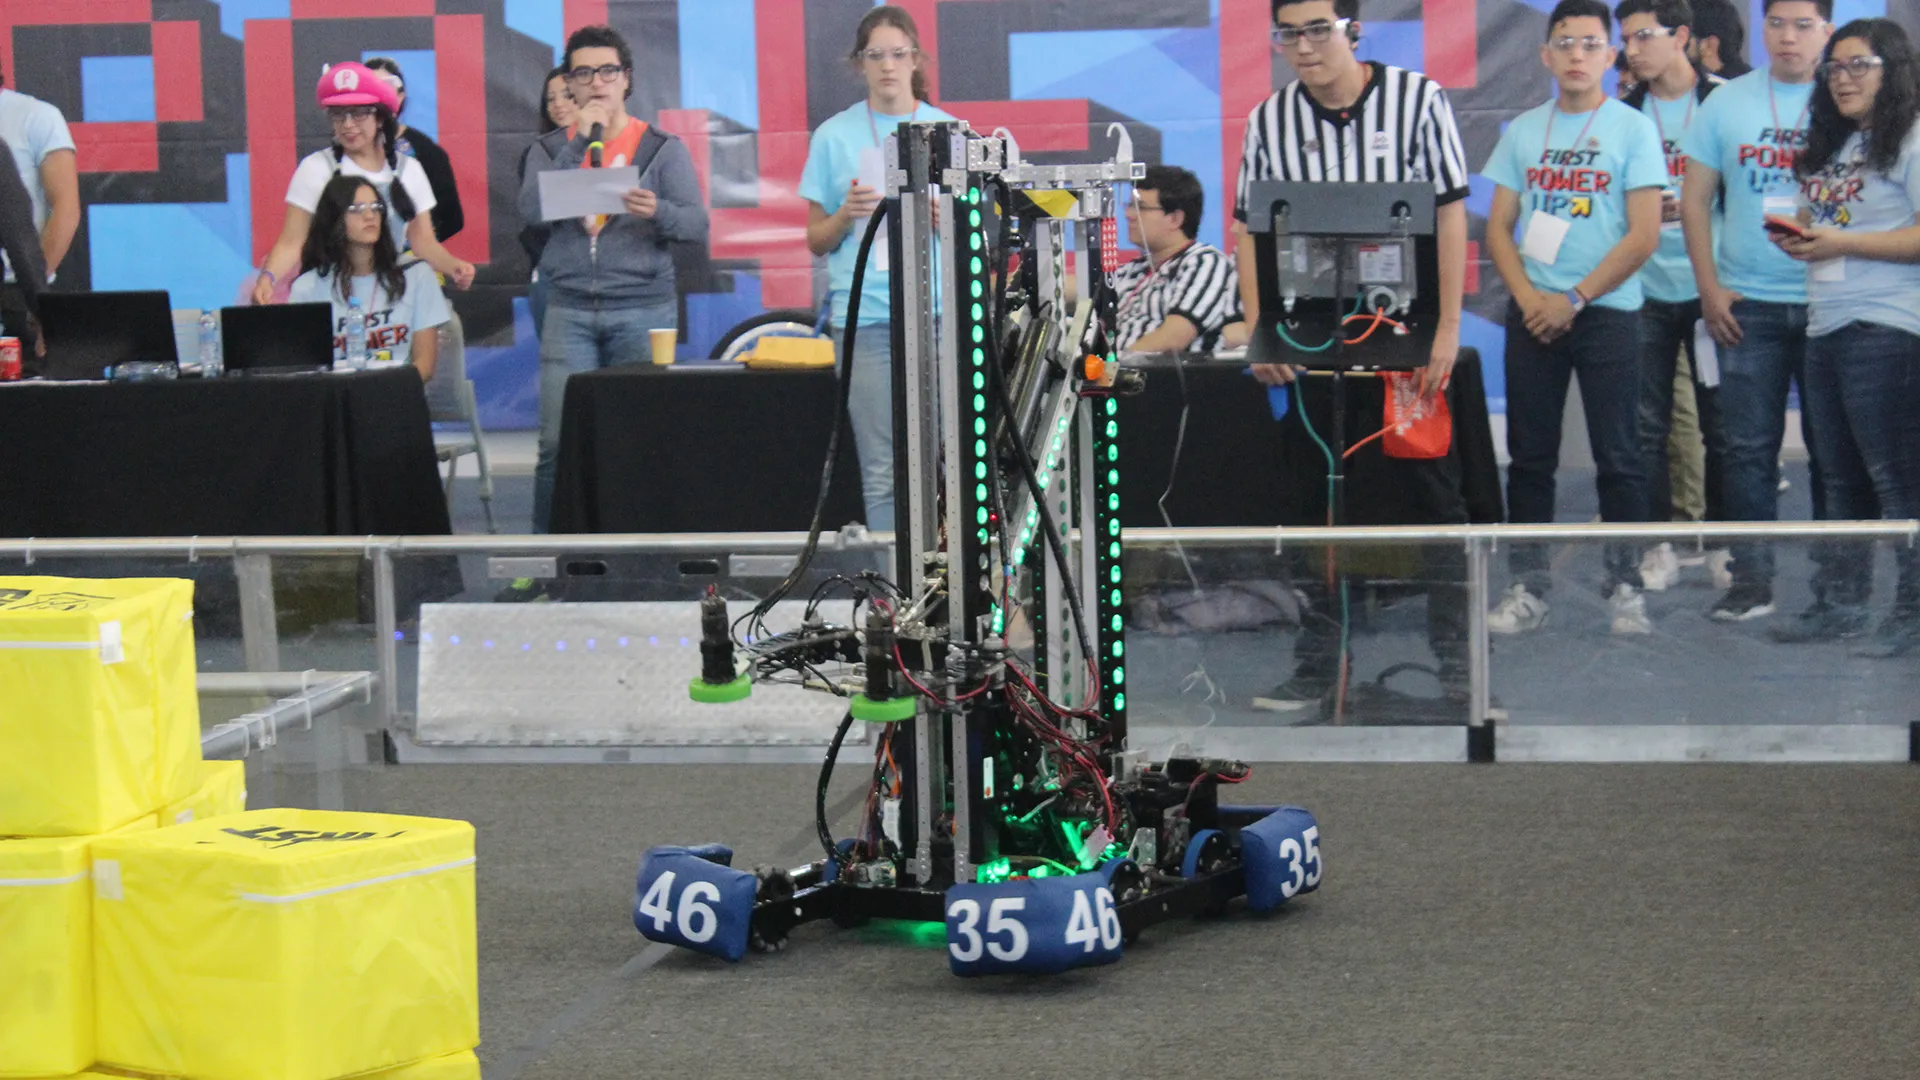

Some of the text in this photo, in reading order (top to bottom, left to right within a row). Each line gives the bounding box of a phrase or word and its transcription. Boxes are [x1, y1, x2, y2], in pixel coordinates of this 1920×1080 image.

[1759, 127, 1808, 145] FIRS
[1539, 149, 1601, 166] FIRST
[1738, 144, 1806, 169] POW
[1526, 166, 1612, 194] POWER
[1532, 192, 1569, 216] UP
[337, 308, 394, 332] FST
[1279, 825, 1322, 898] 35
[640, 870, 721, 943] 46
[948, 887, 1122, 962] 35 46
